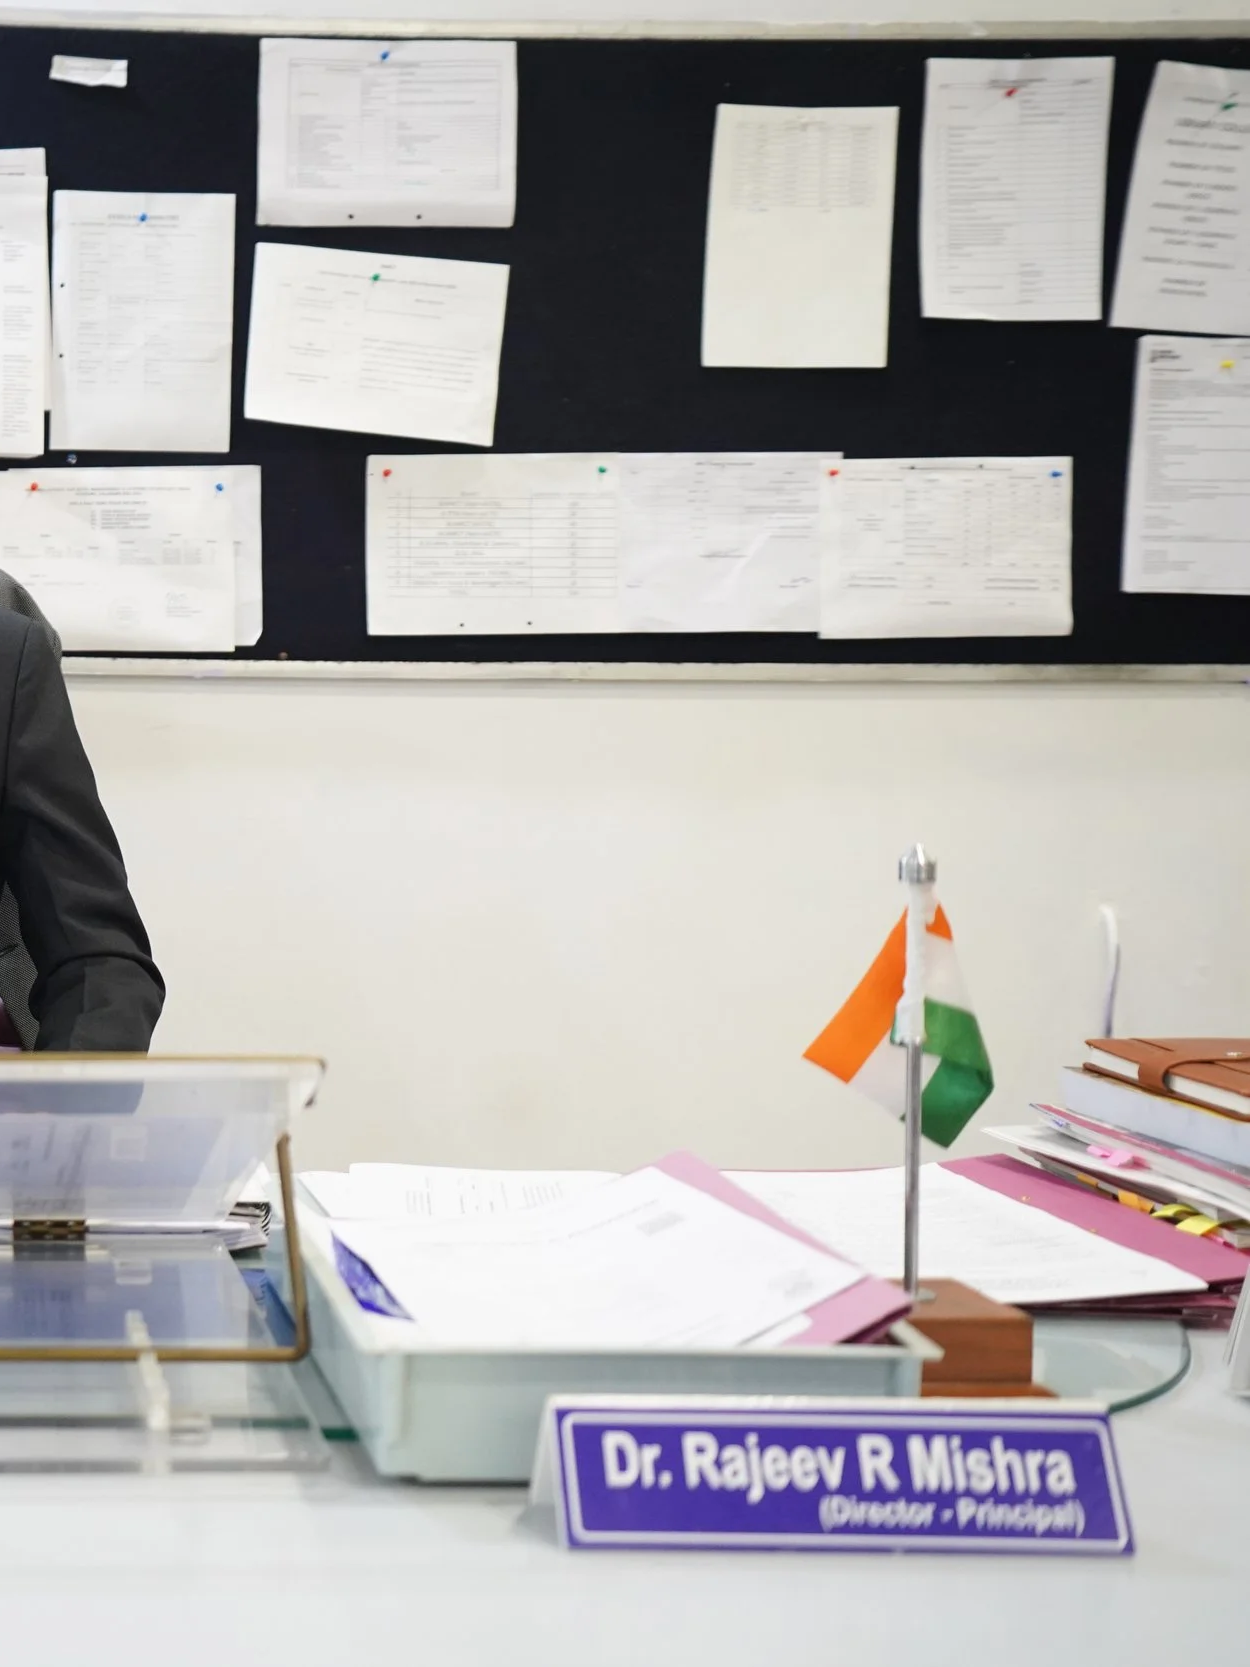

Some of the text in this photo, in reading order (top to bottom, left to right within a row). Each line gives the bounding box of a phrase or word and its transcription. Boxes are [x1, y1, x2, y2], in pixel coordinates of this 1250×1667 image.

[601, 1429, 1077, 1505] Dr. Rajeev R Mishra
[818, 1494, 937, 1533] (Director
[955, 1496, 1086, 1538] Principal)
